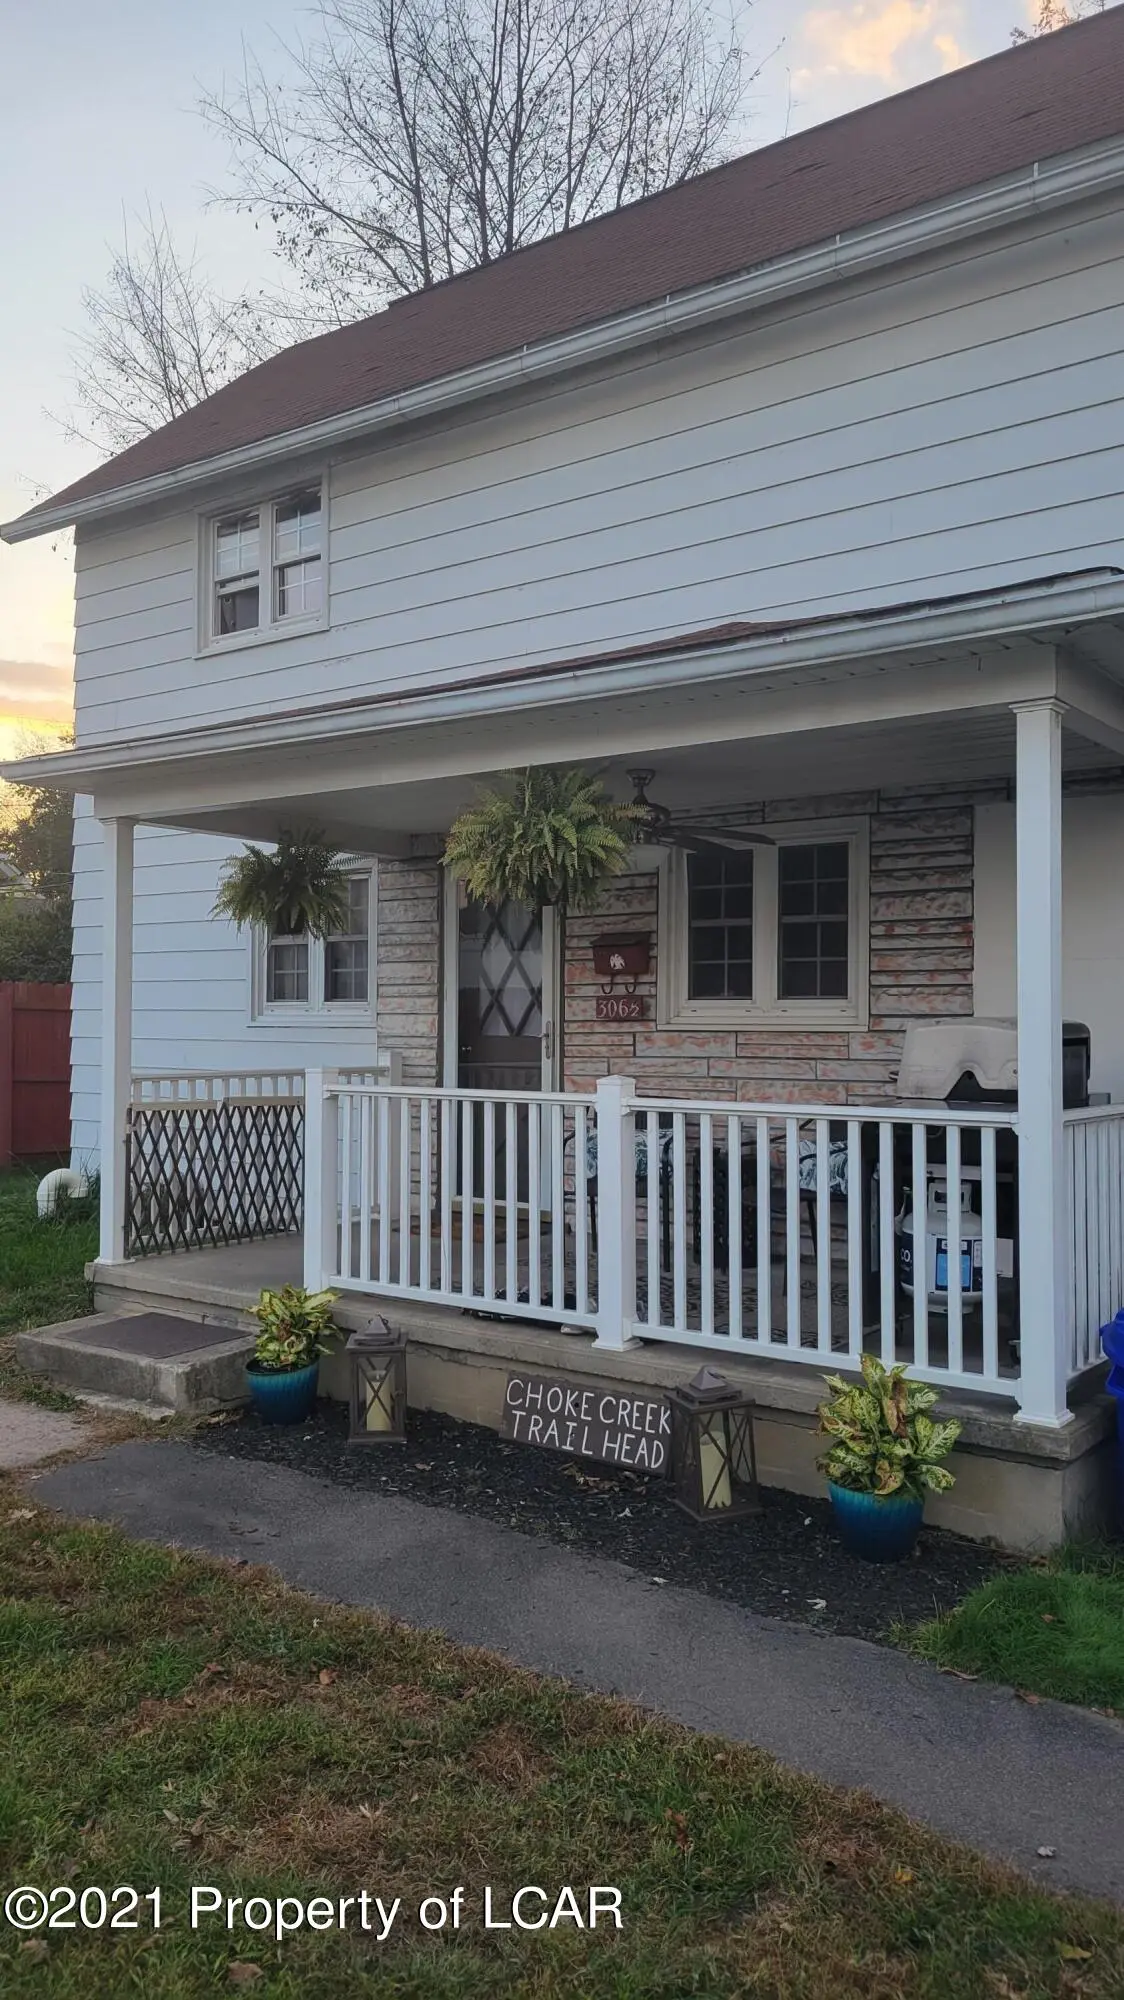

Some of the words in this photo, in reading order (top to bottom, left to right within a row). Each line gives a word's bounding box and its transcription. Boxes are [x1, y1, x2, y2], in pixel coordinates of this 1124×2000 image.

[506, 1379, 595, 1421] CHOKE
[599, 1396, 672, 1434] CREEK
[511, 1410, 593, 1455] TRAIL
[602, 1429, 664, 1469] HEAD
